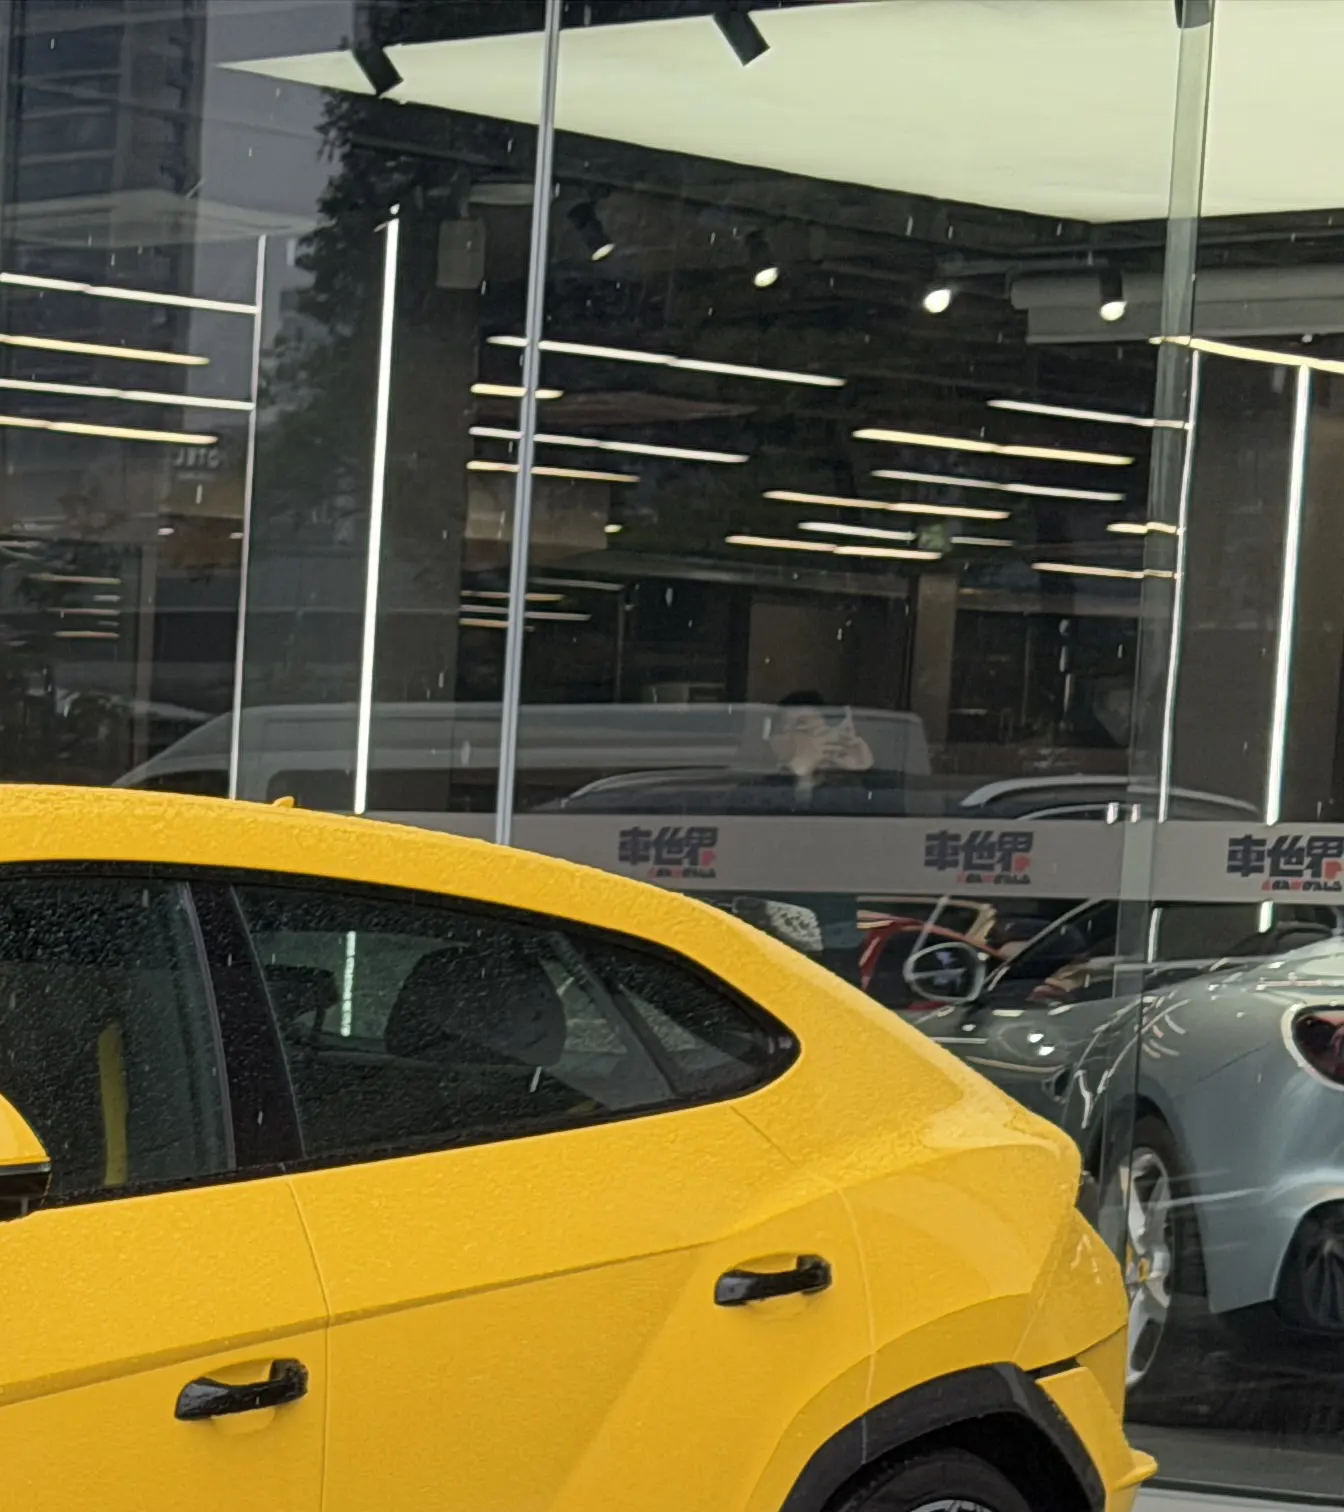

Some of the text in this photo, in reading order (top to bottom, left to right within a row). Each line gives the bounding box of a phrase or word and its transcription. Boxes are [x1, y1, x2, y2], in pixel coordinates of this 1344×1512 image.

[618, 826, 719, 868] 車世界
[924, 830, 1035, 873] 車世界
[1226, 833, 1344, 880] 車世界
